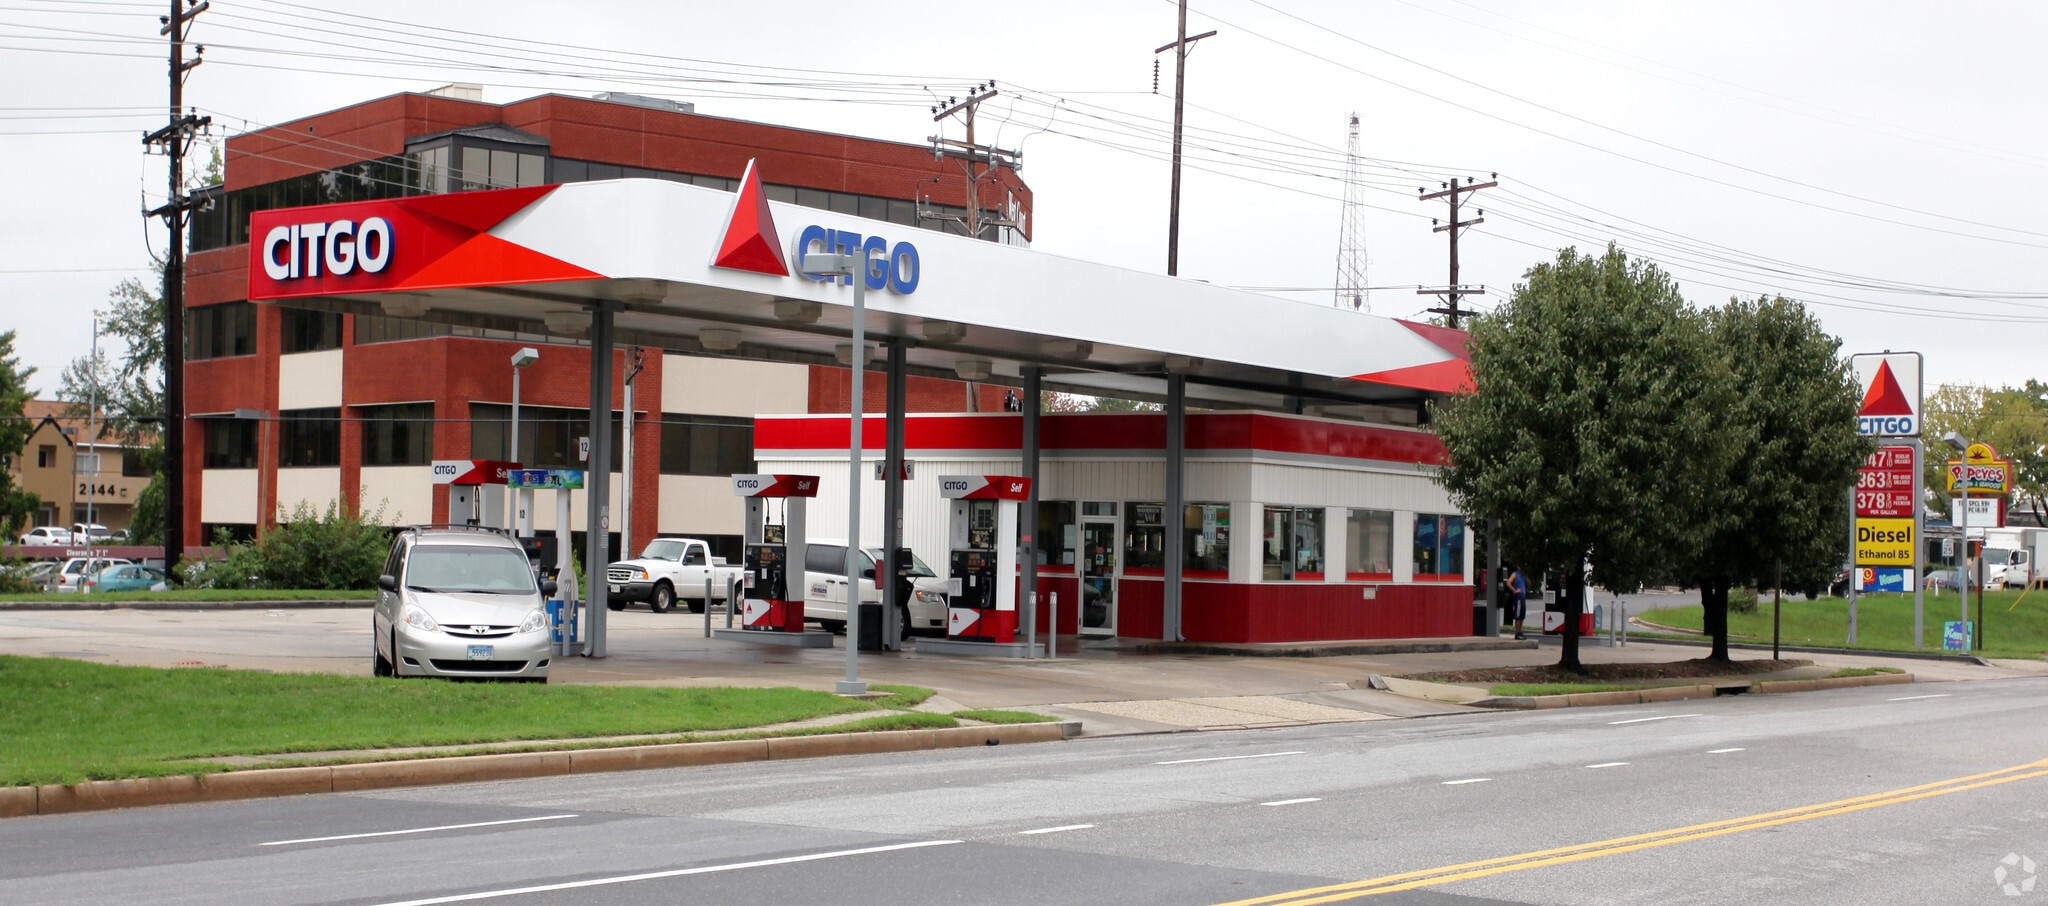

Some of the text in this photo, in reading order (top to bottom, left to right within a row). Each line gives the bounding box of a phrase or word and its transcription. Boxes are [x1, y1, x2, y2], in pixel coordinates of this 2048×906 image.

[263, 216, 395, 281] CITGO
[797, 224, 920, 295] CITGO
[1859, 417, 1912, 434] CITGO
[580, 442, 588, 452] 12
[1863, 451, 1886, 467] 47
[434, 465, 456, 475] CITGO
[496, 467, 509, 479] Sel
[877, 464, 882, 474] 8
[906, 464, 911, 474] 6
[737, 479, 759, 489] CITGO
[797, 480, 811, 491] Self
[944, 481, 968, 491] CITGO
[1857, 472, 1886, 489] 363
[1010, 482, 1024, 493] Self
[1857, 492, 1885, 509] 378
[519, 509, 525, 519] 12
[1858, 526, 1911, 542] Diesel
[1858, 549, 1910, 559] Ethanol 85
